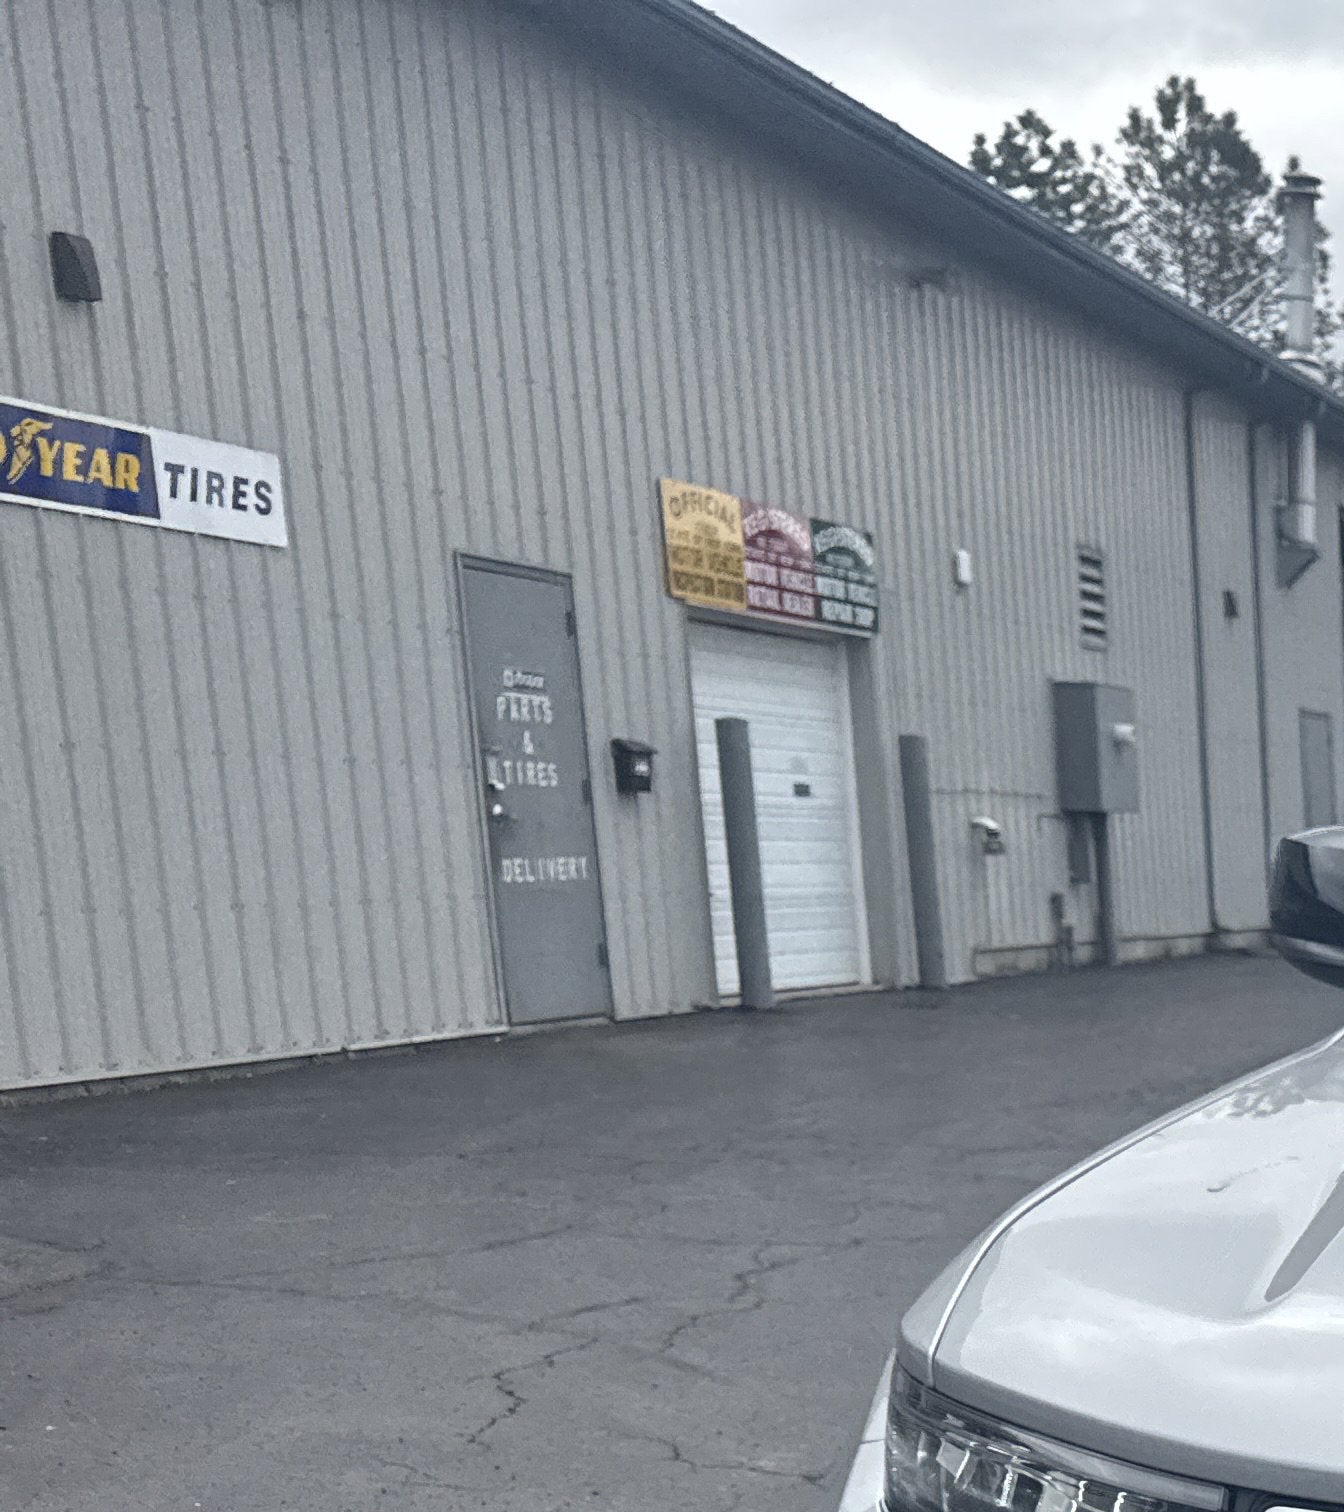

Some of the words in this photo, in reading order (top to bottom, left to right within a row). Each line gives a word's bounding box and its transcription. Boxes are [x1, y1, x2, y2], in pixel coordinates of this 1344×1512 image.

[163, 461, 273, 516] TIRES
[496, 696, 553, 723] PARTS
[523, 730, 534, 754] &
[503, 760, 559, 787] TIRES
[502, 856, 587, 883] DELIVERY
